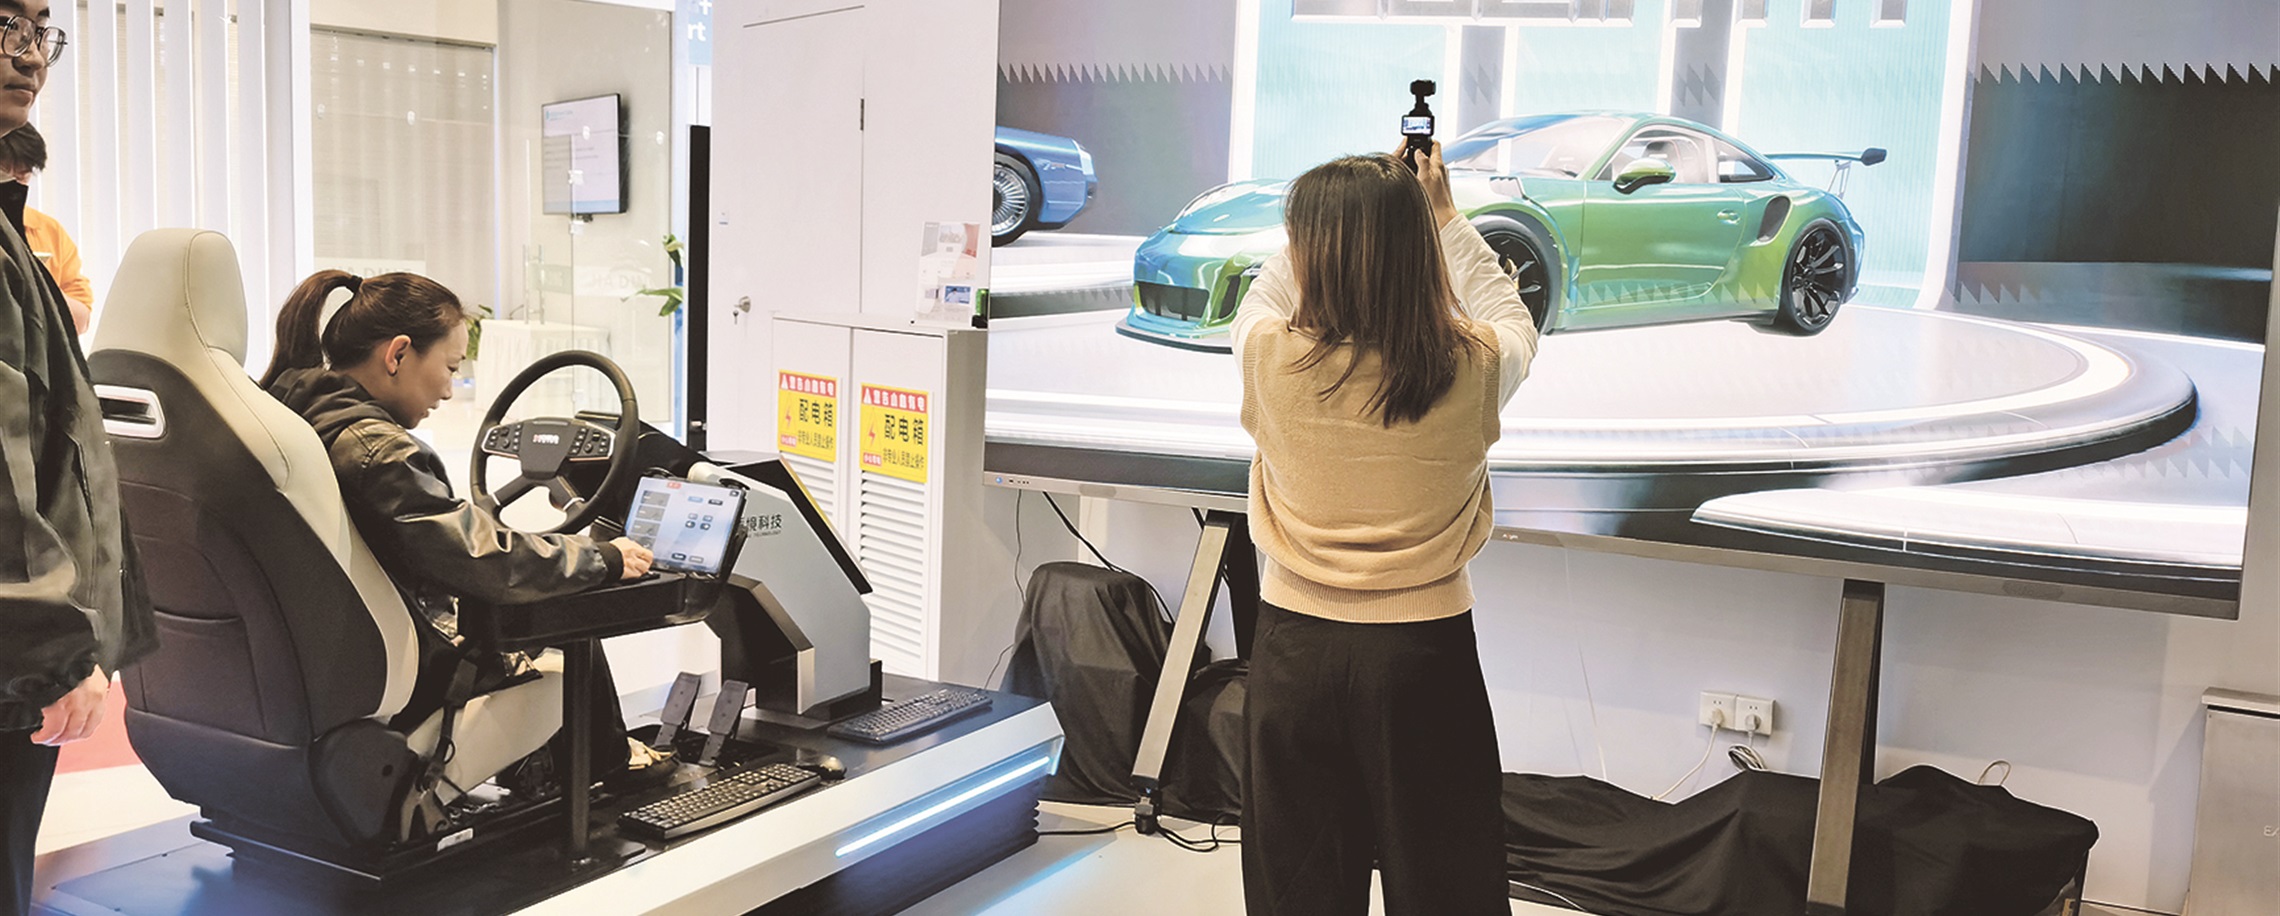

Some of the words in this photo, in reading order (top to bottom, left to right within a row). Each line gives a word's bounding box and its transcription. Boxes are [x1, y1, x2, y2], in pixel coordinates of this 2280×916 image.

[799, 398, 833, 428] 配电箱
[885, 413, 924, 445] 配电箱
